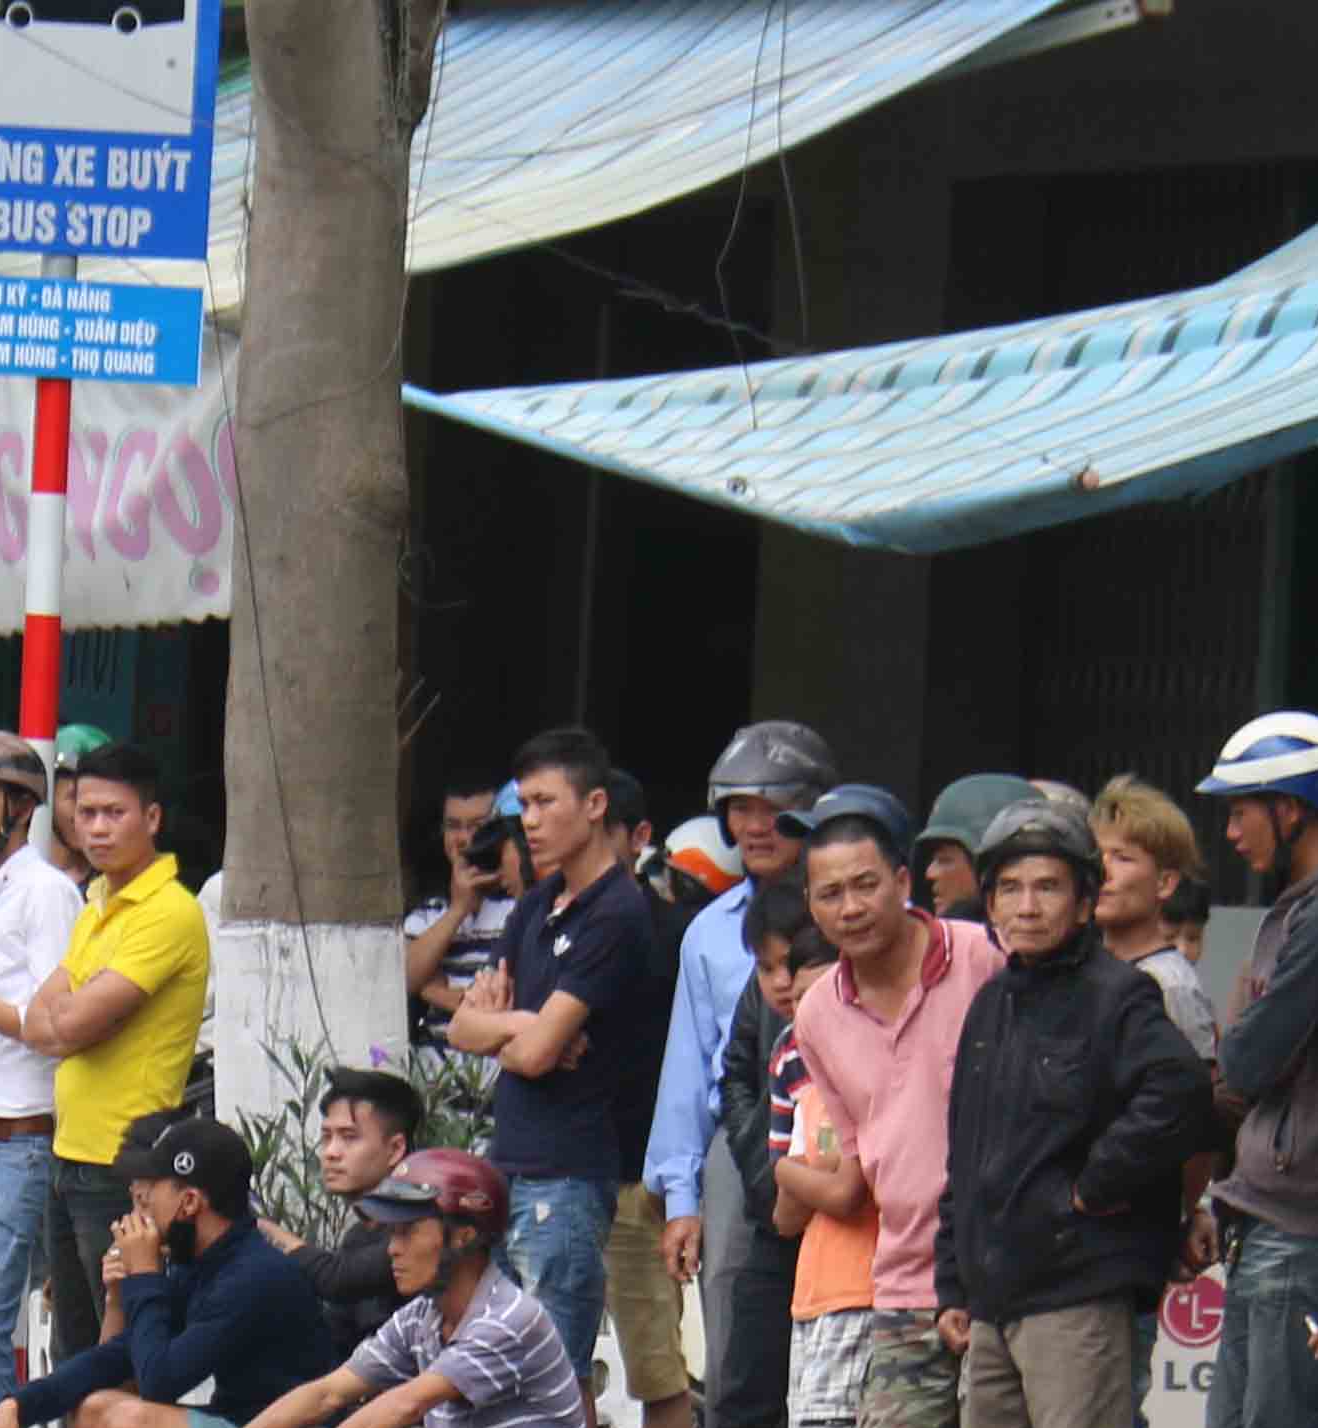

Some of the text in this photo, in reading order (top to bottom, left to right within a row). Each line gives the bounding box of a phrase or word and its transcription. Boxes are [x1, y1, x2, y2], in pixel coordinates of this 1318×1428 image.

[53, 147, 96, 187] XE
[107, 141, 192, 192] BUÝT
[66, 203, 152, 247] STOP
[74, 317, 116, 344] XUÂN
[71, 349, 99, 376] THỌ
[103, 350, 155, 375] QUANG
[1163, 1361, 1216, 1391] LG
